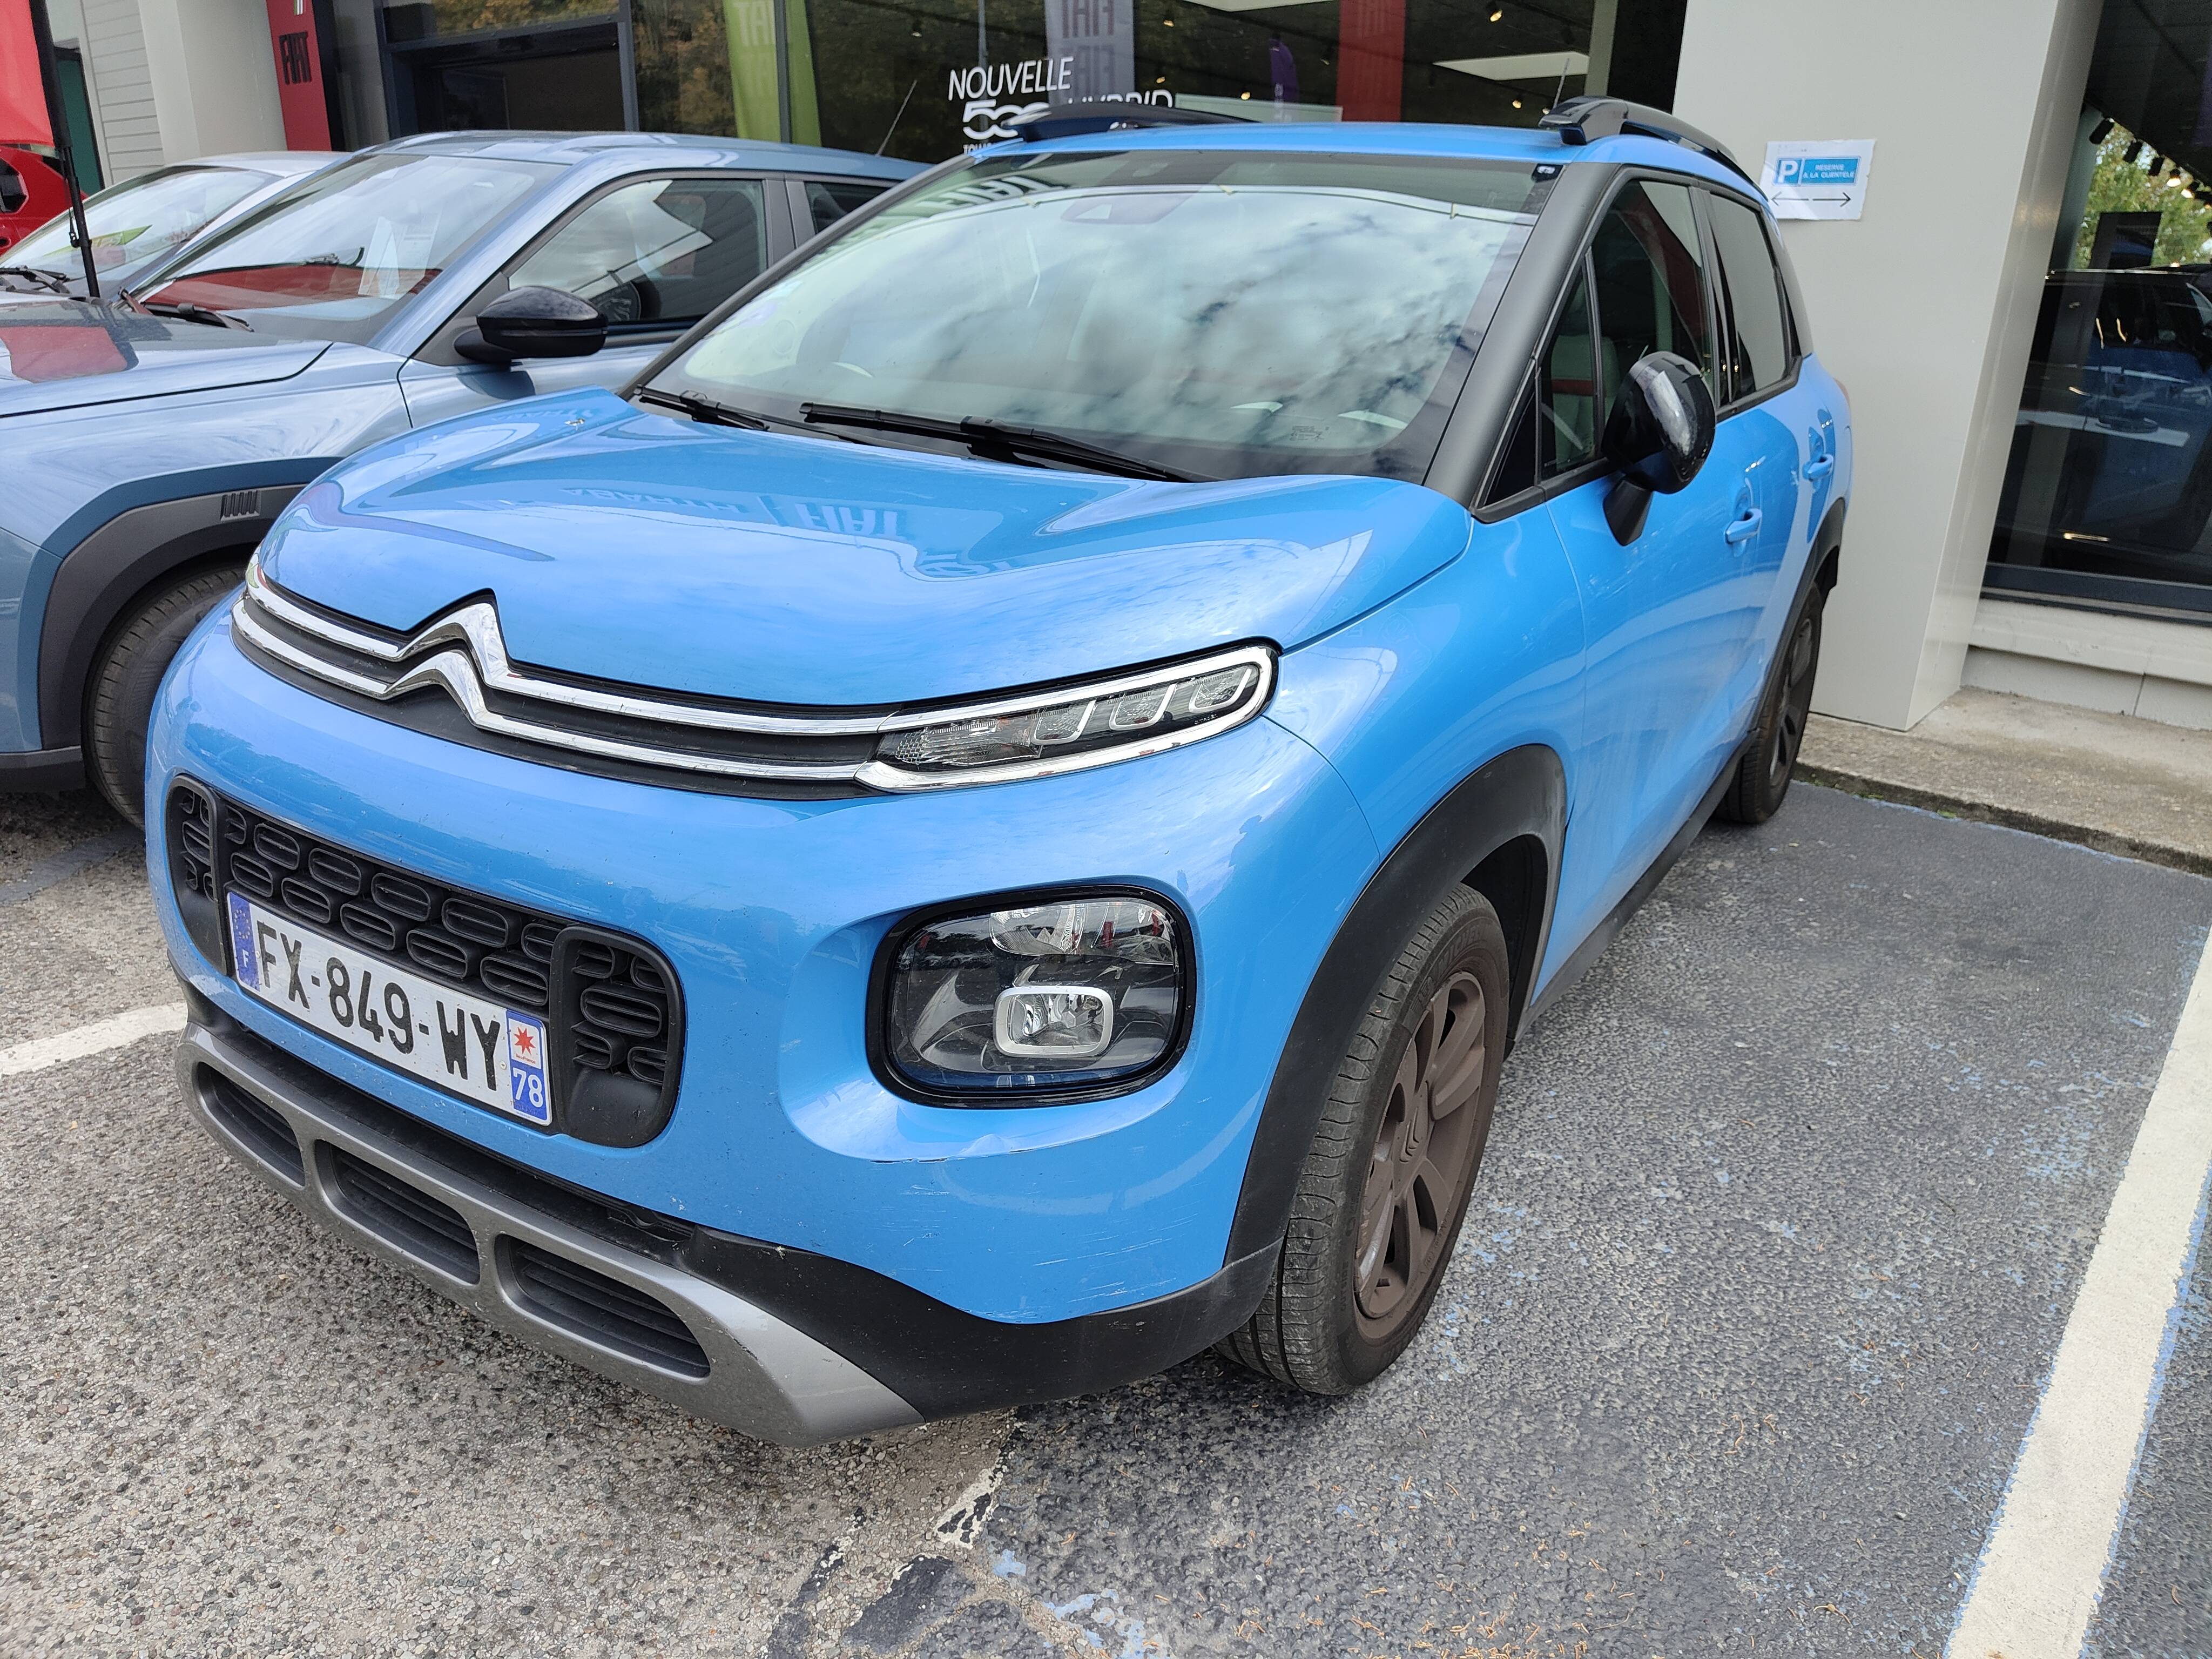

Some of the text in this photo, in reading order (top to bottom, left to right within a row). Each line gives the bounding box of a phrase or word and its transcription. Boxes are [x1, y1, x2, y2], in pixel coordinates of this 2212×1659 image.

[279, 31, 312, 85] FIAT
[948, 56, 1074, 101] NOUVELLE
[1778, 160, 1799, 183] P
[242, 949, 250, 968] F
[257, 920, 501, 1091] FX-849-WY
[512, 1068, 544, 1108] 78
